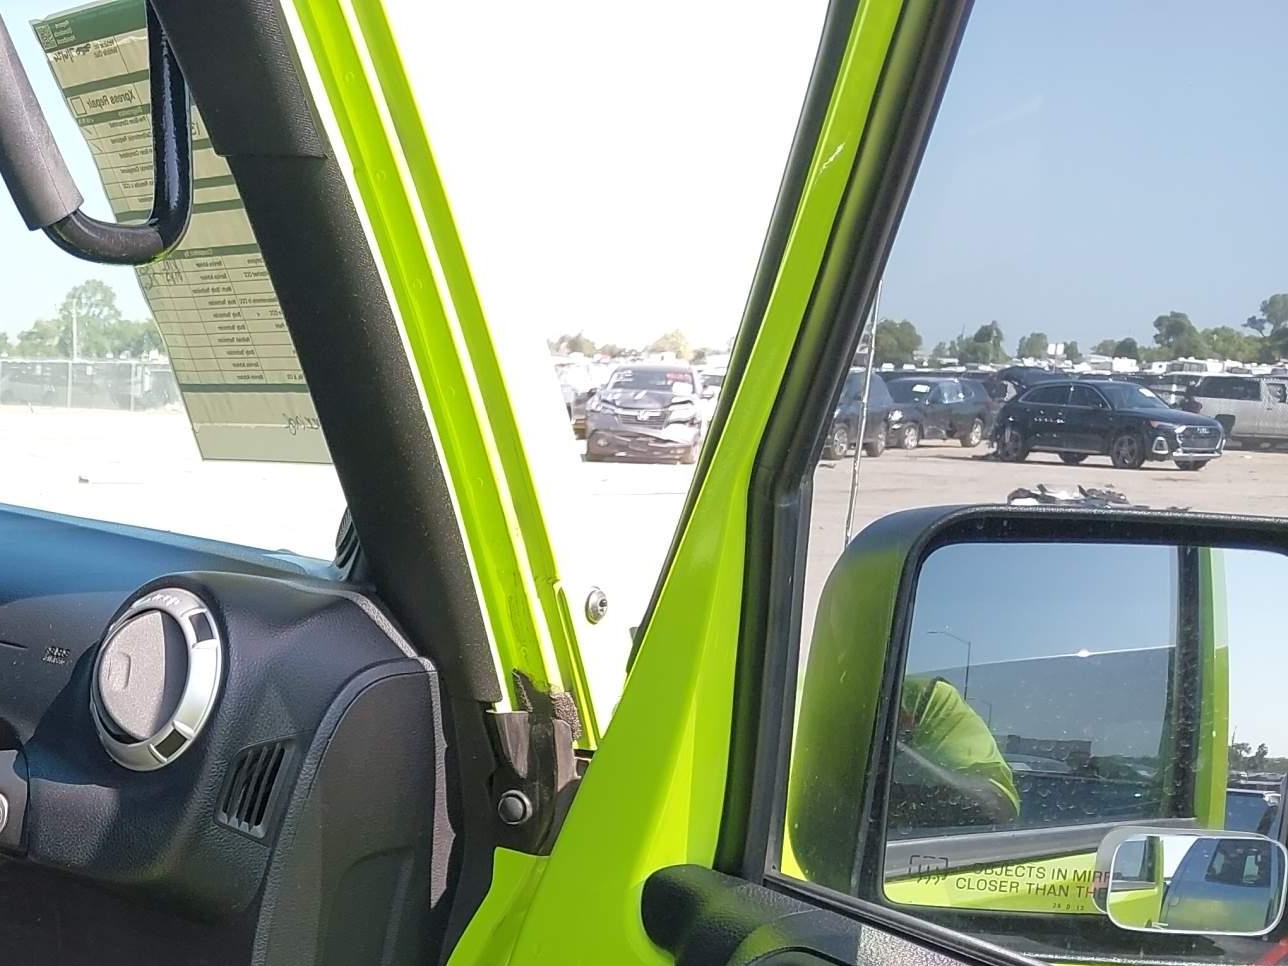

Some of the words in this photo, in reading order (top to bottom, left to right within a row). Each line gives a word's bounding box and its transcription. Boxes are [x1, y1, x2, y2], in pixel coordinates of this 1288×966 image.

[974, 863, 1046, 879] OBJECTS
[1051, 869, 1067, 880] IN
[955, 877, 1020, 893] CLOSER
[1026, 882, 1069, 897] THAN
